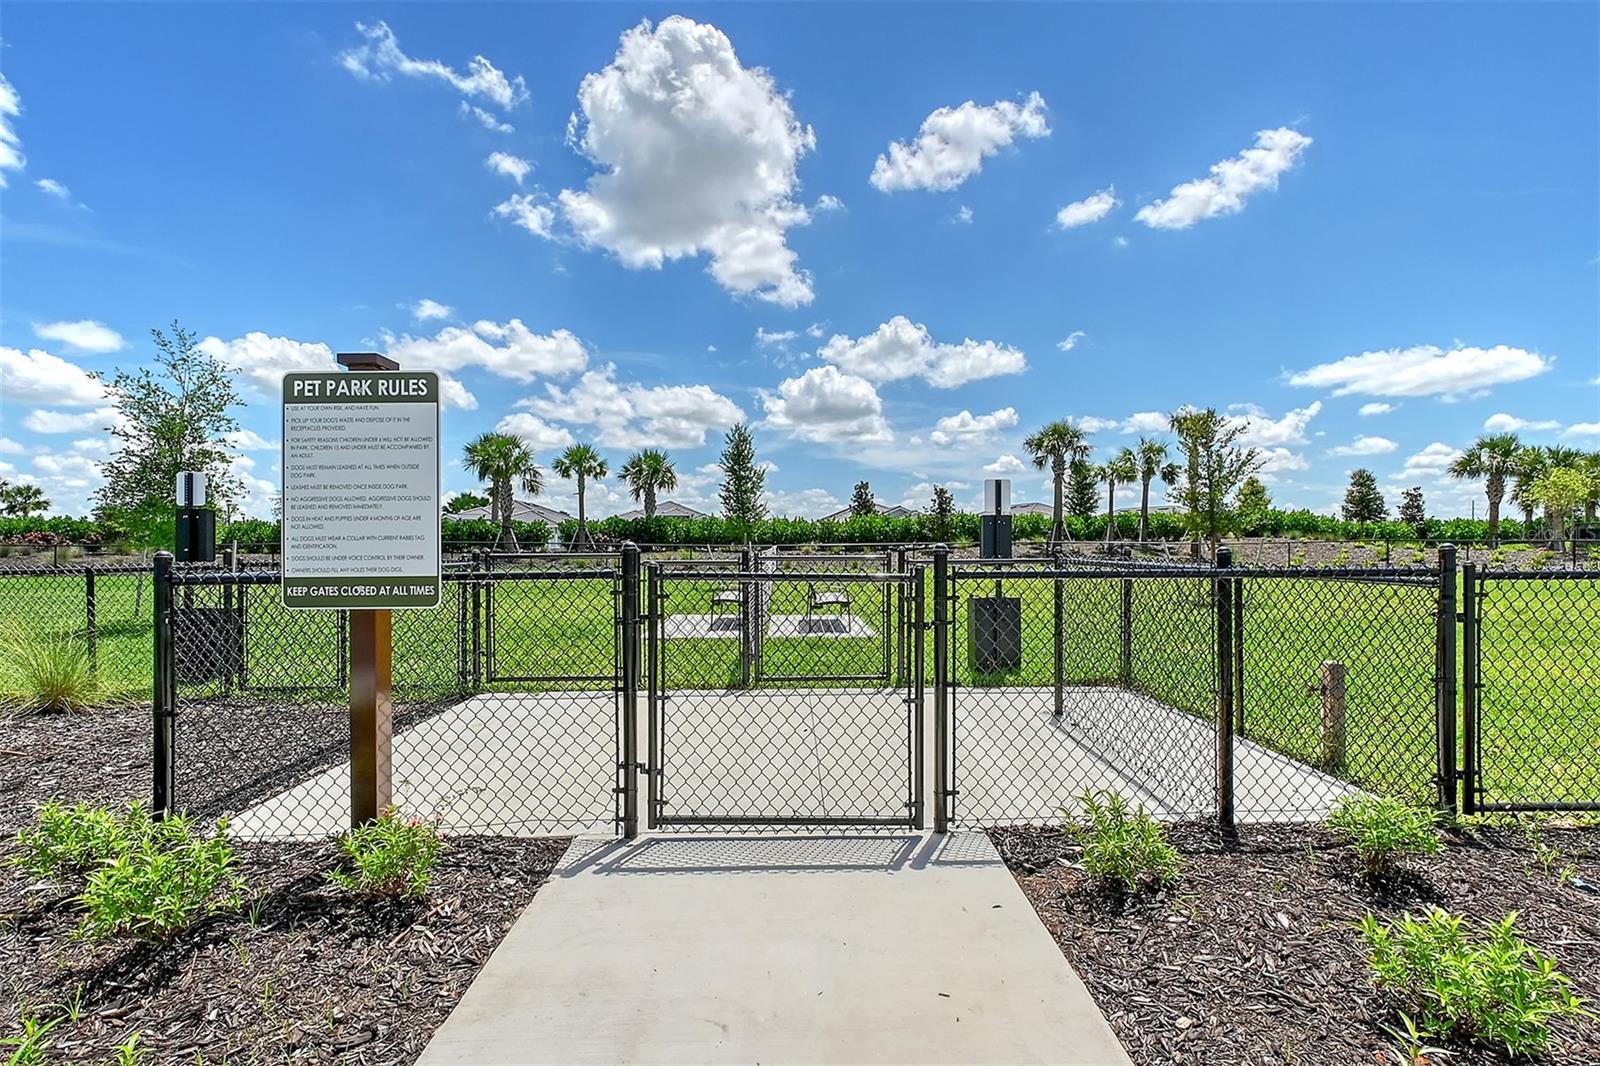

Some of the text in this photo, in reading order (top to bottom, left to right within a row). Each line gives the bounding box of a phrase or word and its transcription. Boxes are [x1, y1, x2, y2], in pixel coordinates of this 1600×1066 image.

[293, 379, 428, 397] PET PARK RULES
[286, 585, 435, 597] KEEP GATES CLOSED AT ALL TIMES
